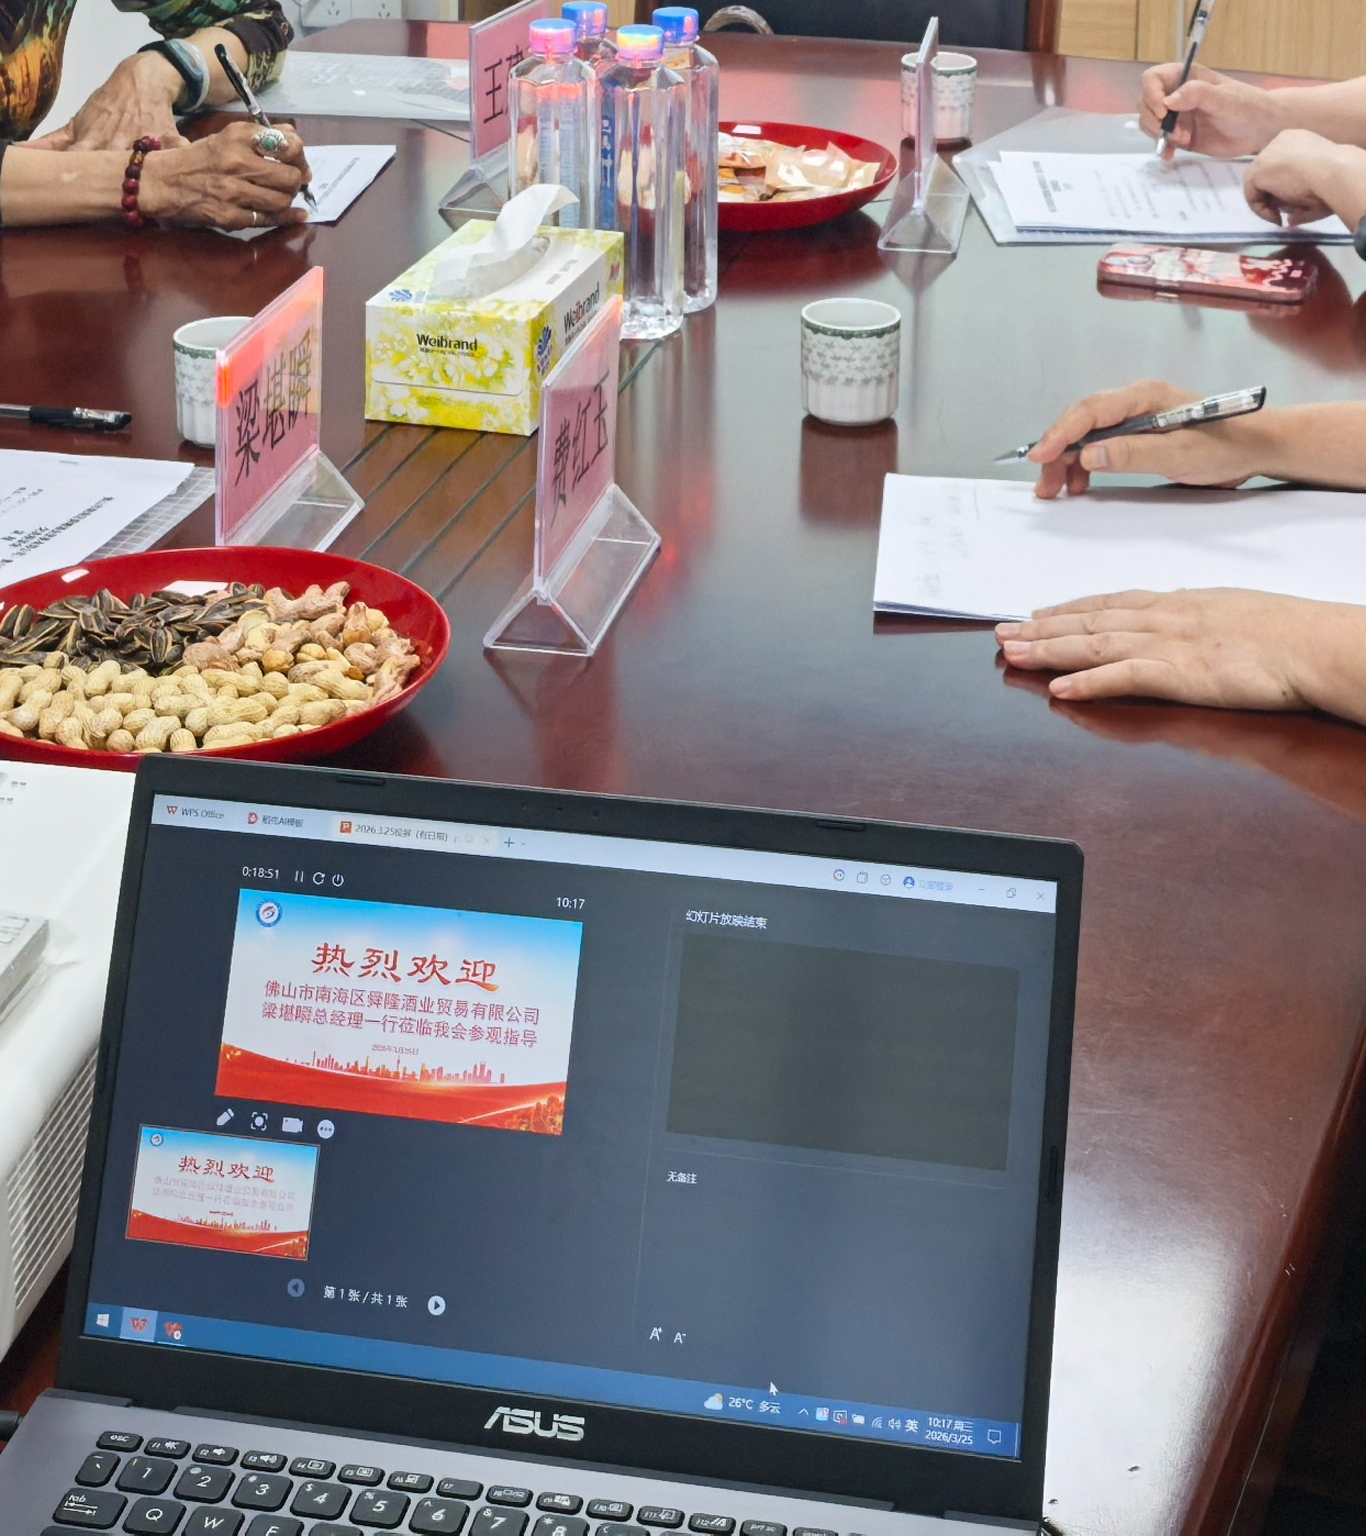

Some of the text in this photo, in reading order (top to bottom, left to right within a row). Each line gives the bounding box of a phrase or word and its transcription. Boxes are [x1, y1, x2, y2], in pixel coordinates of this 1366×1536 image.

[417, 334, 477, 351] Weibrand
[181, 806, 225, 820] WPS Office
[242, 867, 280, 880] 0:18:51
[556, 897, 585, 910] 10:17
[686, 909, 767, 929] 幻灯片放映结束
[311, 942, 500, 992] 热烈欢迎
[264, 979, 540, 1025] 佛山市南海区舜隆酒业贸易有限公司
[262, 1001, 537, 1048] 梁堪瞬总经理一行莅临我会参观指导
[178, 1155, 275, 1183] 热烈欢迎
[667, 1171, 697, 1184] 无备注
[758, 1399, 780, 1415] 多云
[484, 1406, 585, 1441] ASUS
[905, 1419, 918, 1433] 英
[927, 1416, 953, 1430] 10:17
[925, 1429, 973, 1445] 2026/3/25
[142, 1467, 152, 1479] 1
[196, 1476, 212, 1488] 2
[255, 1483, 270, 1495] 3
[313, 1492, 328, 1504] 4
[372, 1500, 387, 1512] 5
[146, 1508, 163, 1521] Q
[432, 1508, 446, 1521] 6
[204, 1516, 224, 1529] W
[489, 1516, 507, 1529] 7
